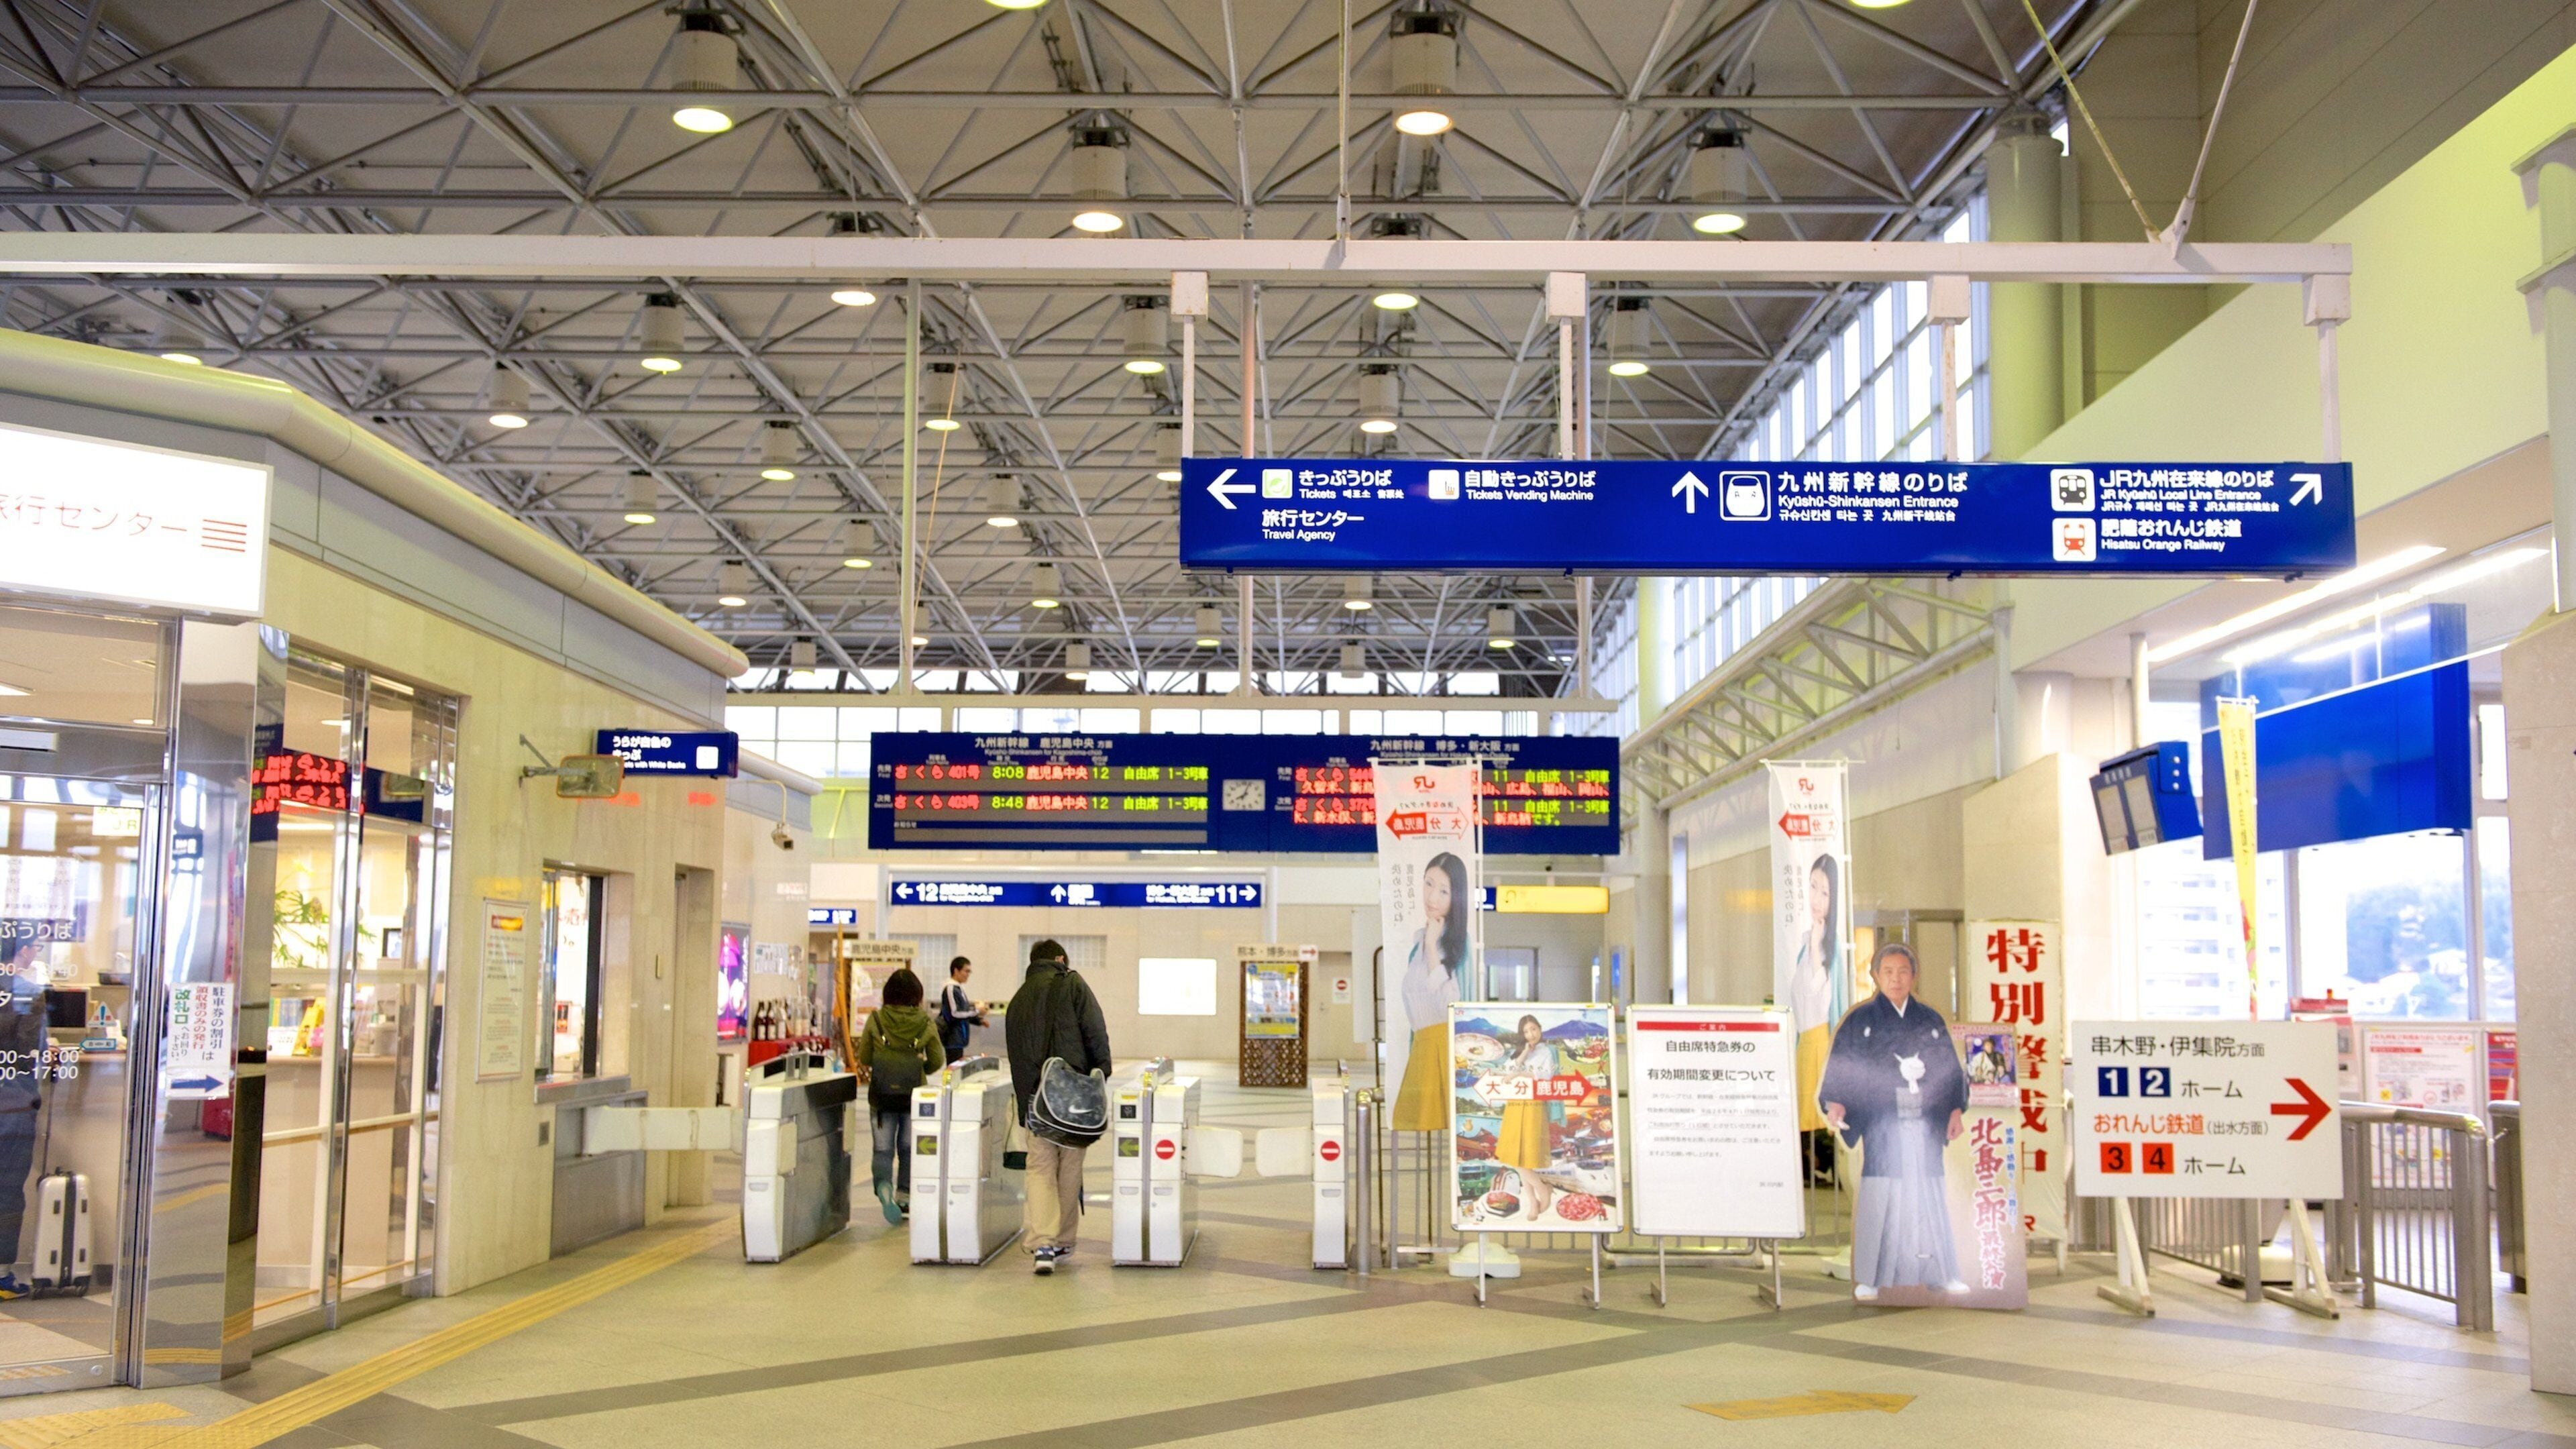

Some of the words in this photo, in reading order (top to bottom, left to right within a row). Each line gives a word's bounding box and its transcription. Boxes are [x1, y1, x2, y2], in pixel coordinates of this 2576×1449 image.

[1299, 470, 1392, 486] きっぷうりば
[1465, 470, 1596, 488] 自動きっぷうりば
[1778, 471, 1968, 492] 九州新幹線のりば
[2100, 470, 2274, 488] JR九州在来線のりば
[1299, 489, 1336, 499] Tickets
[1466, 490, 1503, 500] Tickets
[1505, 490, 1548, 502] Vending
[1550, 490, 1593, 501] Machine
[1903, 495, 1959, 508] Entrance
[2100, 490, 2116, 500] JR
[2159, 490, 2188, 500] Local
[2190, 490, 2212, 500] Line
[2215, 490, 2261, 500] Entrance
[1262, 509, 1364, 527] 旅行センター
[1263, 529, 1295, 539] Travel
[1297, 530, 1336, 541] Agency
[2101, 519, 2242, 537] 肥薩おれんじ鉄道
[2102, 539, 2141, 549] Hisatsu
[2143, 539, 2182, 552] Orange
[2184, 539, 2225, 551] Railway
[975, 737, 1029, 748] 九州新幹線
[1040, 737, 1094, 749] 鹿児島中央
[1370, 740, 1425, 751] 九州新幹線
[993, 766, 1024, 779] 8:08
[1026, 765, 1088, 780] 鹿児島中央
[1093, 767, 1110, 780] 12
[1124, 767, 1159, 780] 自由席
[1493, 770, 1509, 782] 11
[1525, 769, 1561, 782] 自由席
[992, 796, 1024, 809] 8:48
[1026, 796, 1088, 810] 鹿児島中央
[1092, 797, 1109, 809] 12
[1124, 797, 1159, 810] 自由席
[1493, 800, 1509, 812] 11
[1525, 799, 1561, 813] 自由席
[916, 883, 938, 902] 12
[1216, 885, 1237, 903] 11
[174, 988, 191, 1024] 改札口
[1666, 1040, 1756, 1053] 自由席特急券の
[1648, 1068, 1776, 1082] 有効期間変更について
[1486, 1081, 1529, 1095] 大分
[1536, 1080, 1585, 1096] 鹿児島
[2105, 1070, 2119, 1095] 1
[2146, 1071, 2164, 1095] 2
[2182, 1079, 2243, 1098] ホーム
[2094, 1114, 2204, 1135] おれんじ鉄道
[2108, 1147, 2125, 1171] 3
[2149, 1148, 2166, 1170] 4
[2184, 1157, 2247, 1175] ホーム
[2023, 1215, 2036, 1232] R
